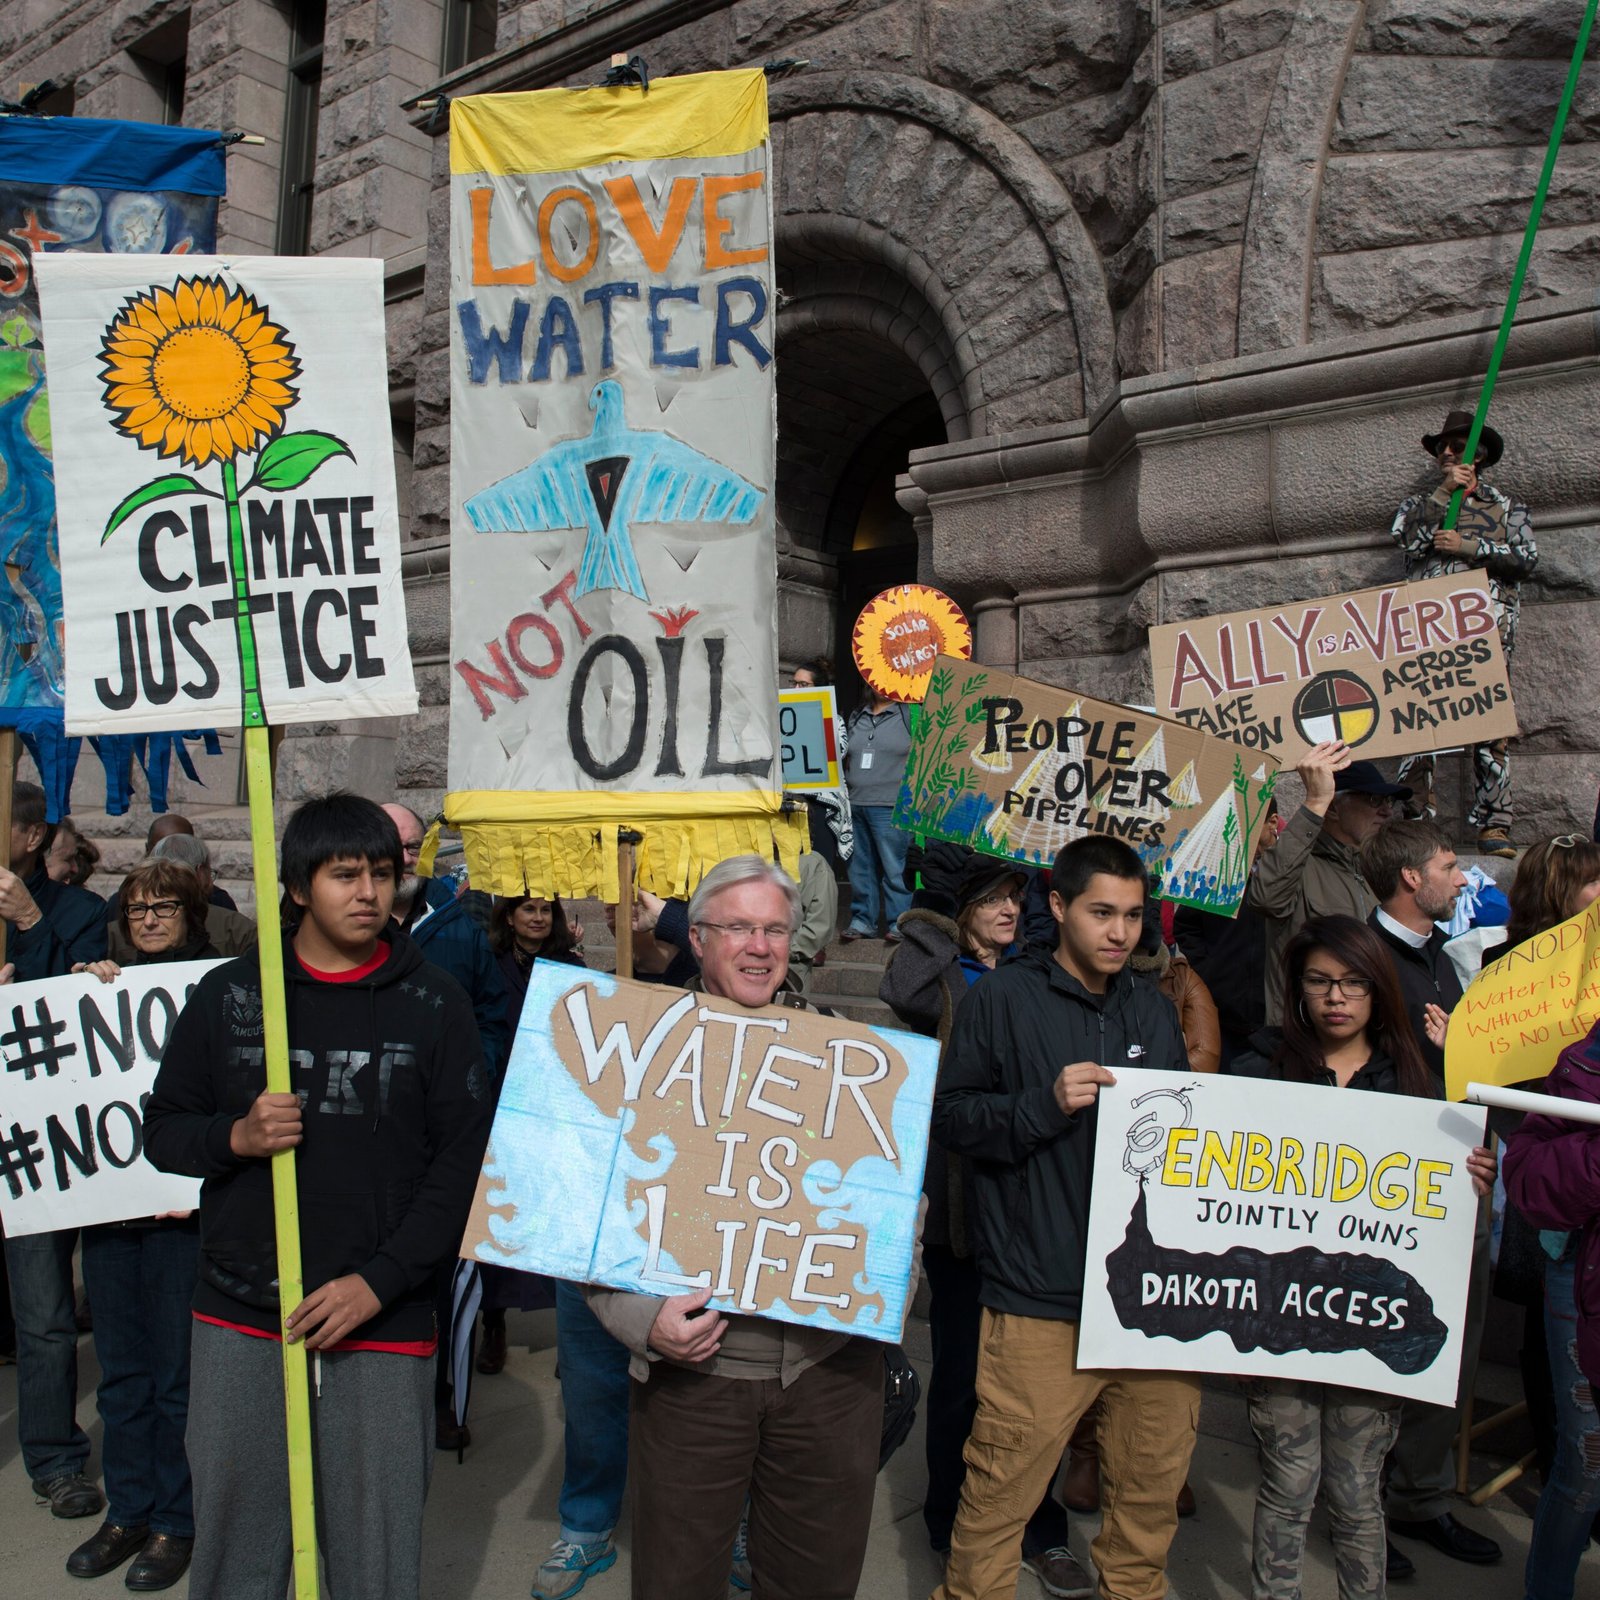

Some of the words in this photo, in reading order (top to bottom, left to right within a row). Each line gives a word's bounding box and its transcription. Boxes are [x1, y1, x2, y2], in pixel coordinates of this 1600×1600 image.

[468, 170, 769, 286] LOVE
[456, 279, 774, 385] WATER
[138, 496, 381, 593] CLIMATE
[95, 586, 386, 711] JUSTICE
[454, 570, 594, 721] NOT
[885, 619, 930, 640] SOLAR
[892, 642, 939, 670] ENERGY
[1316, 634, 1337, 656] IS
[1340, 629, 1364, 651] A
[1342, 588, 1496, 664] VERB
[1169, 607, 1325, 710] ALLY
[1382, 638, 1492, 696] ACROSS
[1411, 668, 1477, 697] THE
[566, 633, 774, 781] OIL
[779, 706, 797, 737] O
[981, 698, 1137, 765] PEOPLE
[1175, 694, 1258, 734] TAKE
[1216, 716, 1284, 750] TION
[1390, 683, 1508, 734] NATIONS
[780, 744, 823, 775] PL
[1054, 758, 1174, 808] OVER
[1475, 903, 1600, 983] #NODA
[1562, 982, 1600, 1010] wat
[0, 983, 198, 1081] #NO
[1489, 1036, 1511, 1055] IS
[1520, 1025, 1549, 1047] NO
[563, 984, 898, 1161] WATER
[0, 1092, 150, 1200] #NO
[705, 1132, 799, 1210] IS
[1161, 1127, 1454, 1221] ENBRIDGE
[638, 1184, 858, 1311] LIFE
[1197, 1198, 1319, 1234] JOINTLY
[1338, 1214, 1419, 1251] OWNS
[1141, 1272, 1258, 1312] DAKOTA
[1280, 1283, 1409, 1331] ACCESS
